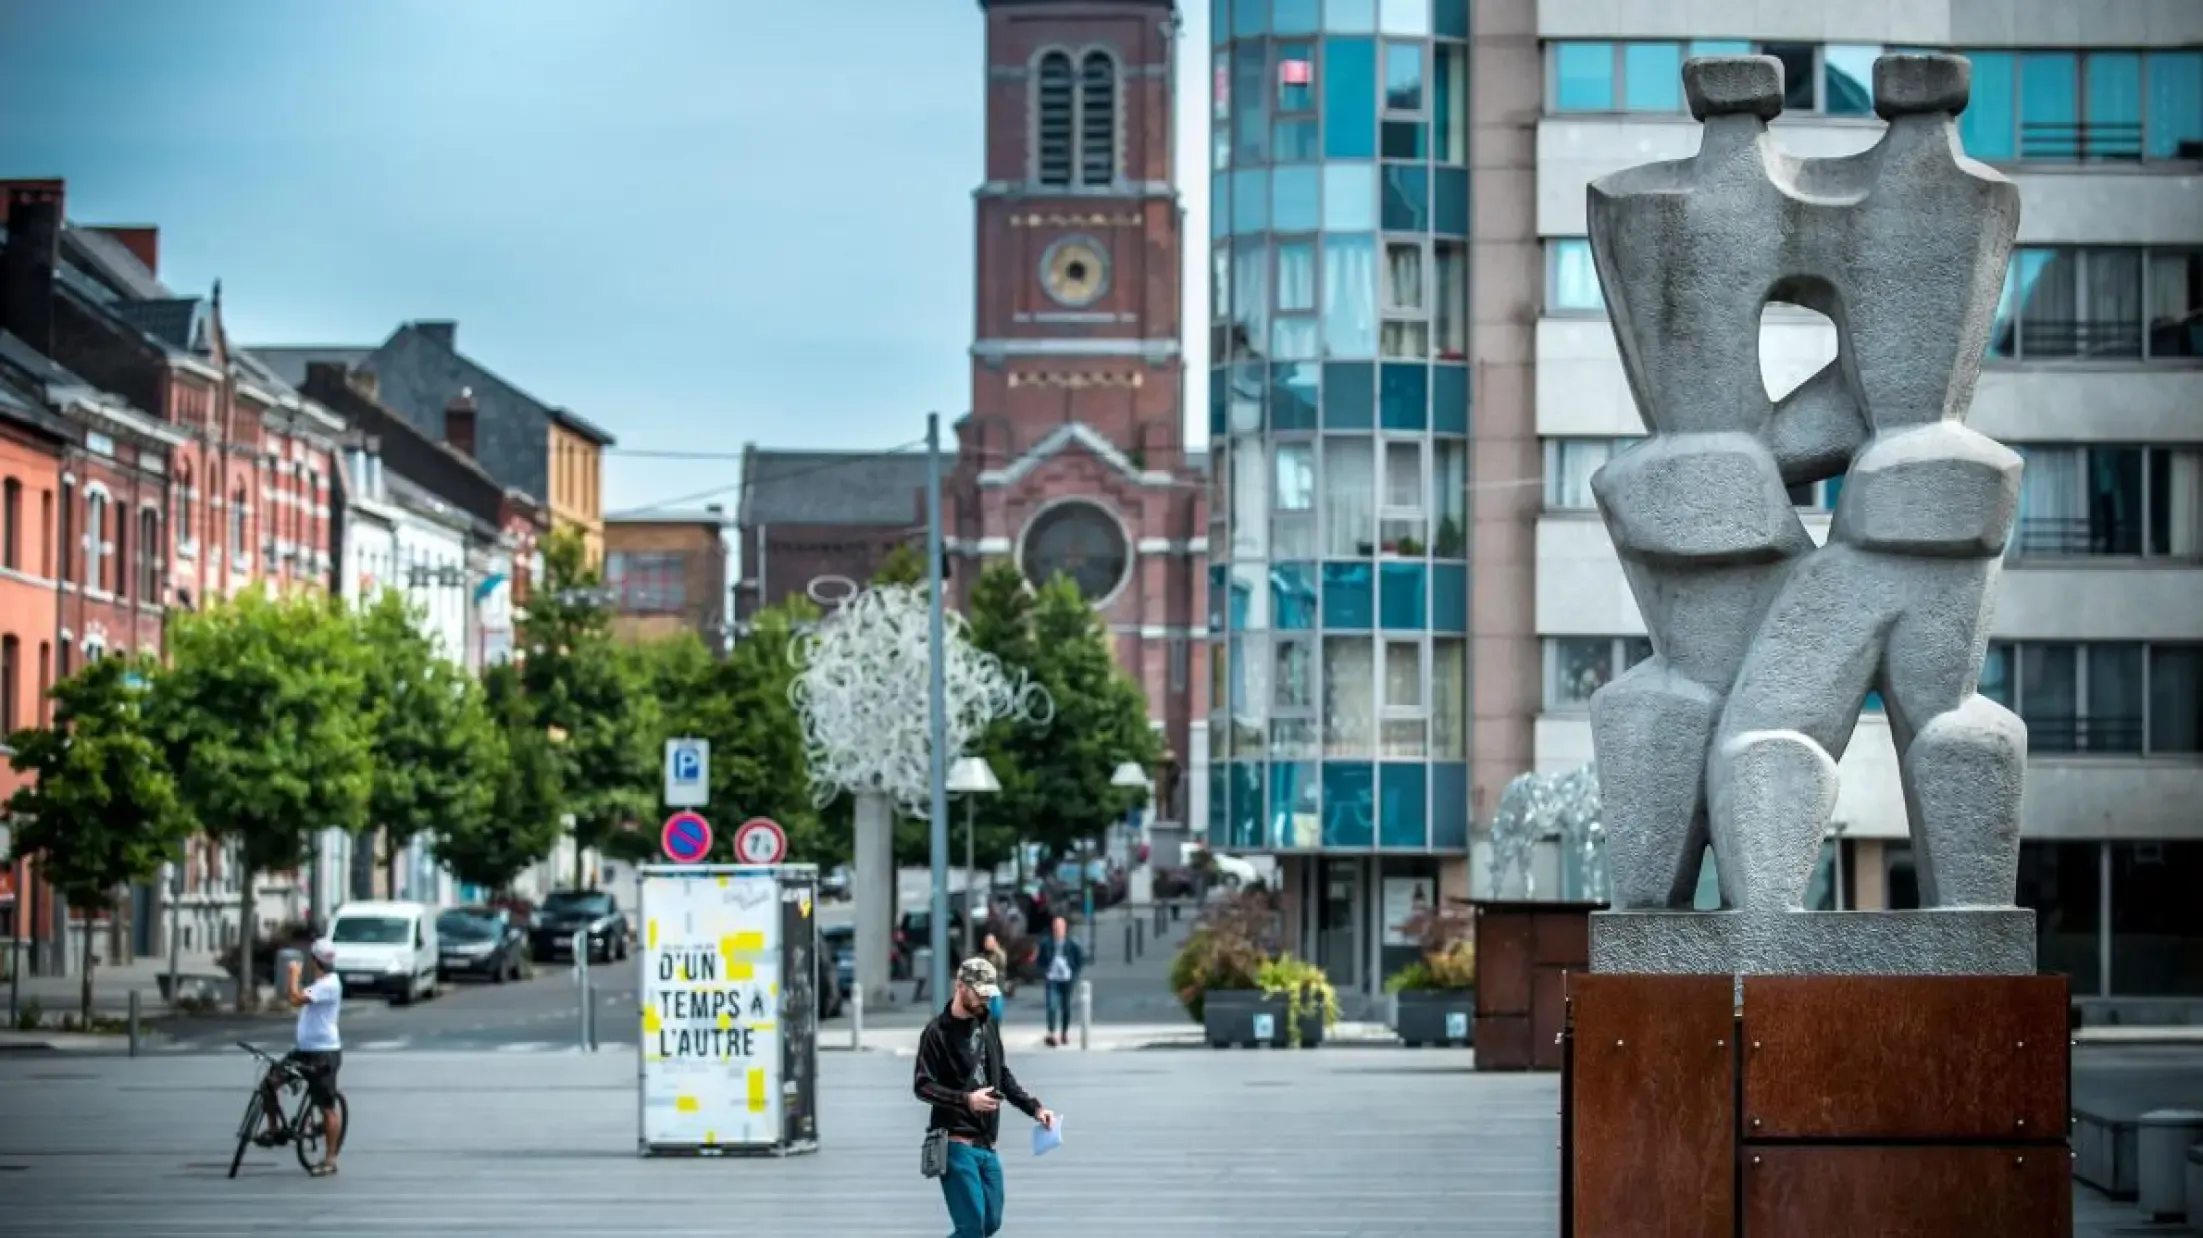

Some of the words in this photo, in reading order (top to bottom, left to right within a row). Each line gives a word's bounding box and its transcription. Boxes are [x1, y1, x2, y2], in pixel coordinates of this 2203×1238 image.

[679, 753, 696, 780] P
[659, 952, 715, 981] D'UN
[659, 989, 741, 1019] TEMPS
[659, 1028, 755, 1058] L'AUTRE
